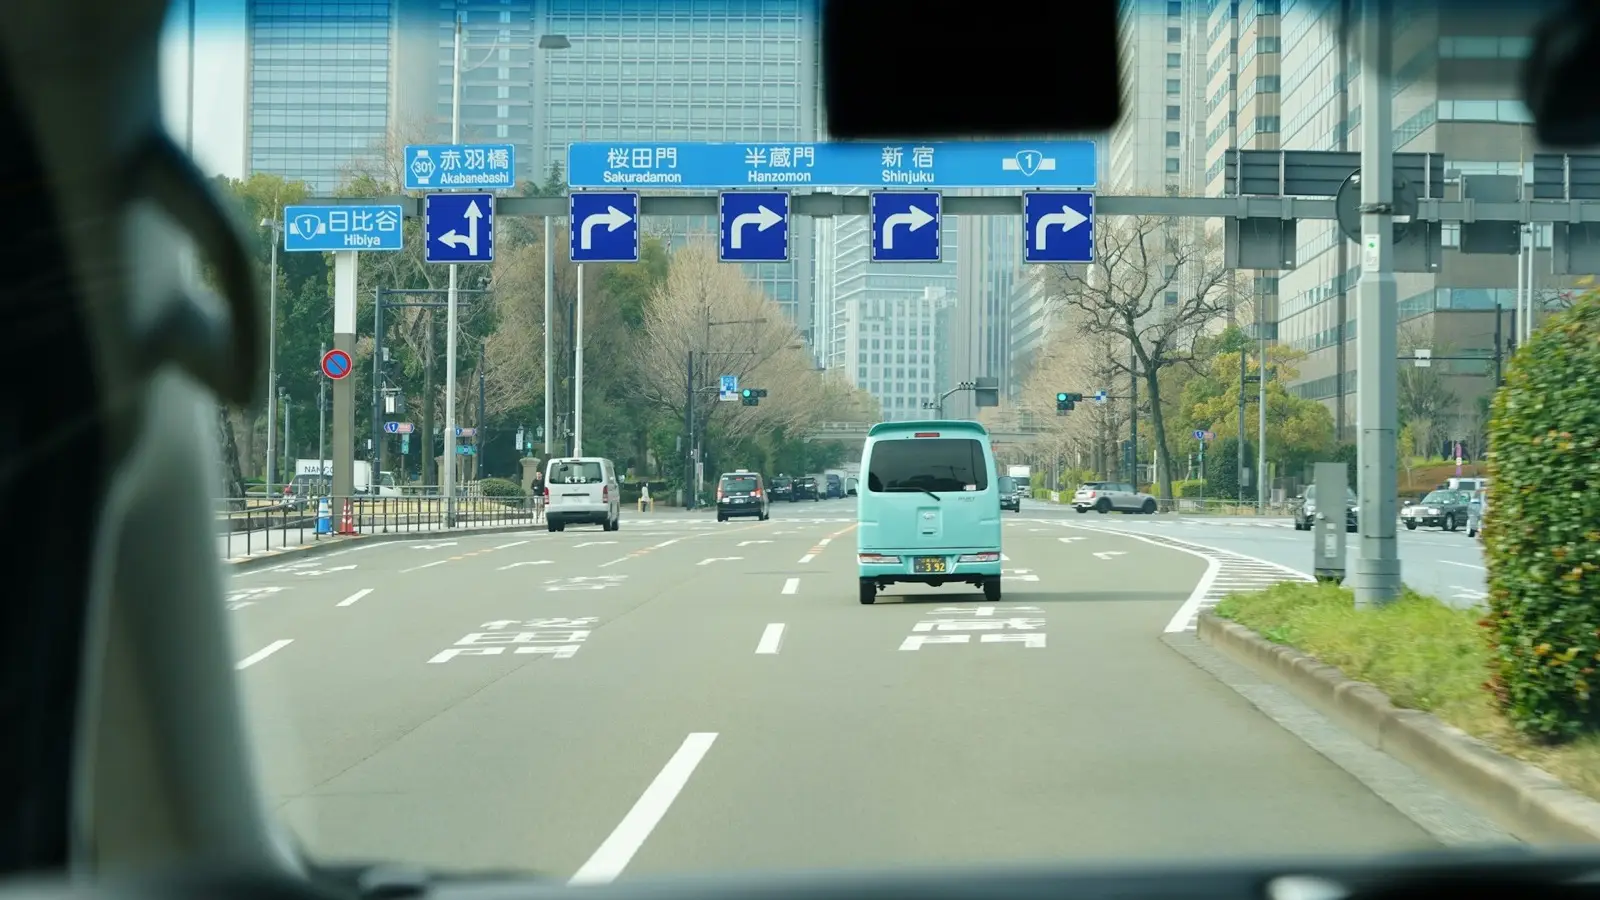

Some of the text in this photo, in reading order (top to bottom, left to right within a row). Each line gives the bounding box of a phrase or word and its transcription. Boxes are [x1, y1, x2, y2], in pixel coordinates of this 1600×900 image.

[440, 149, 509, 170] 赤羽橋
[607, 148, 677, 169] 桜田門
[745, 147, 815, 168] 半蔵門
[881, 147, 935, 168] 新宿
[1024, 154, 1032, 168] 1
[414, 161, 432, 173] 301
[440, 172, 509, 184] Akabanebashi
[603, 171, 681, 183] Sakuradamon
[748, 171, 811, 182] Hanzomon
[882, 170, 934, 184] Shinjuku
[304, 218, 311, 233] 1
[329, 210, 398, 232] 日比谷
[344, 234, 381, 247] Hibiya
